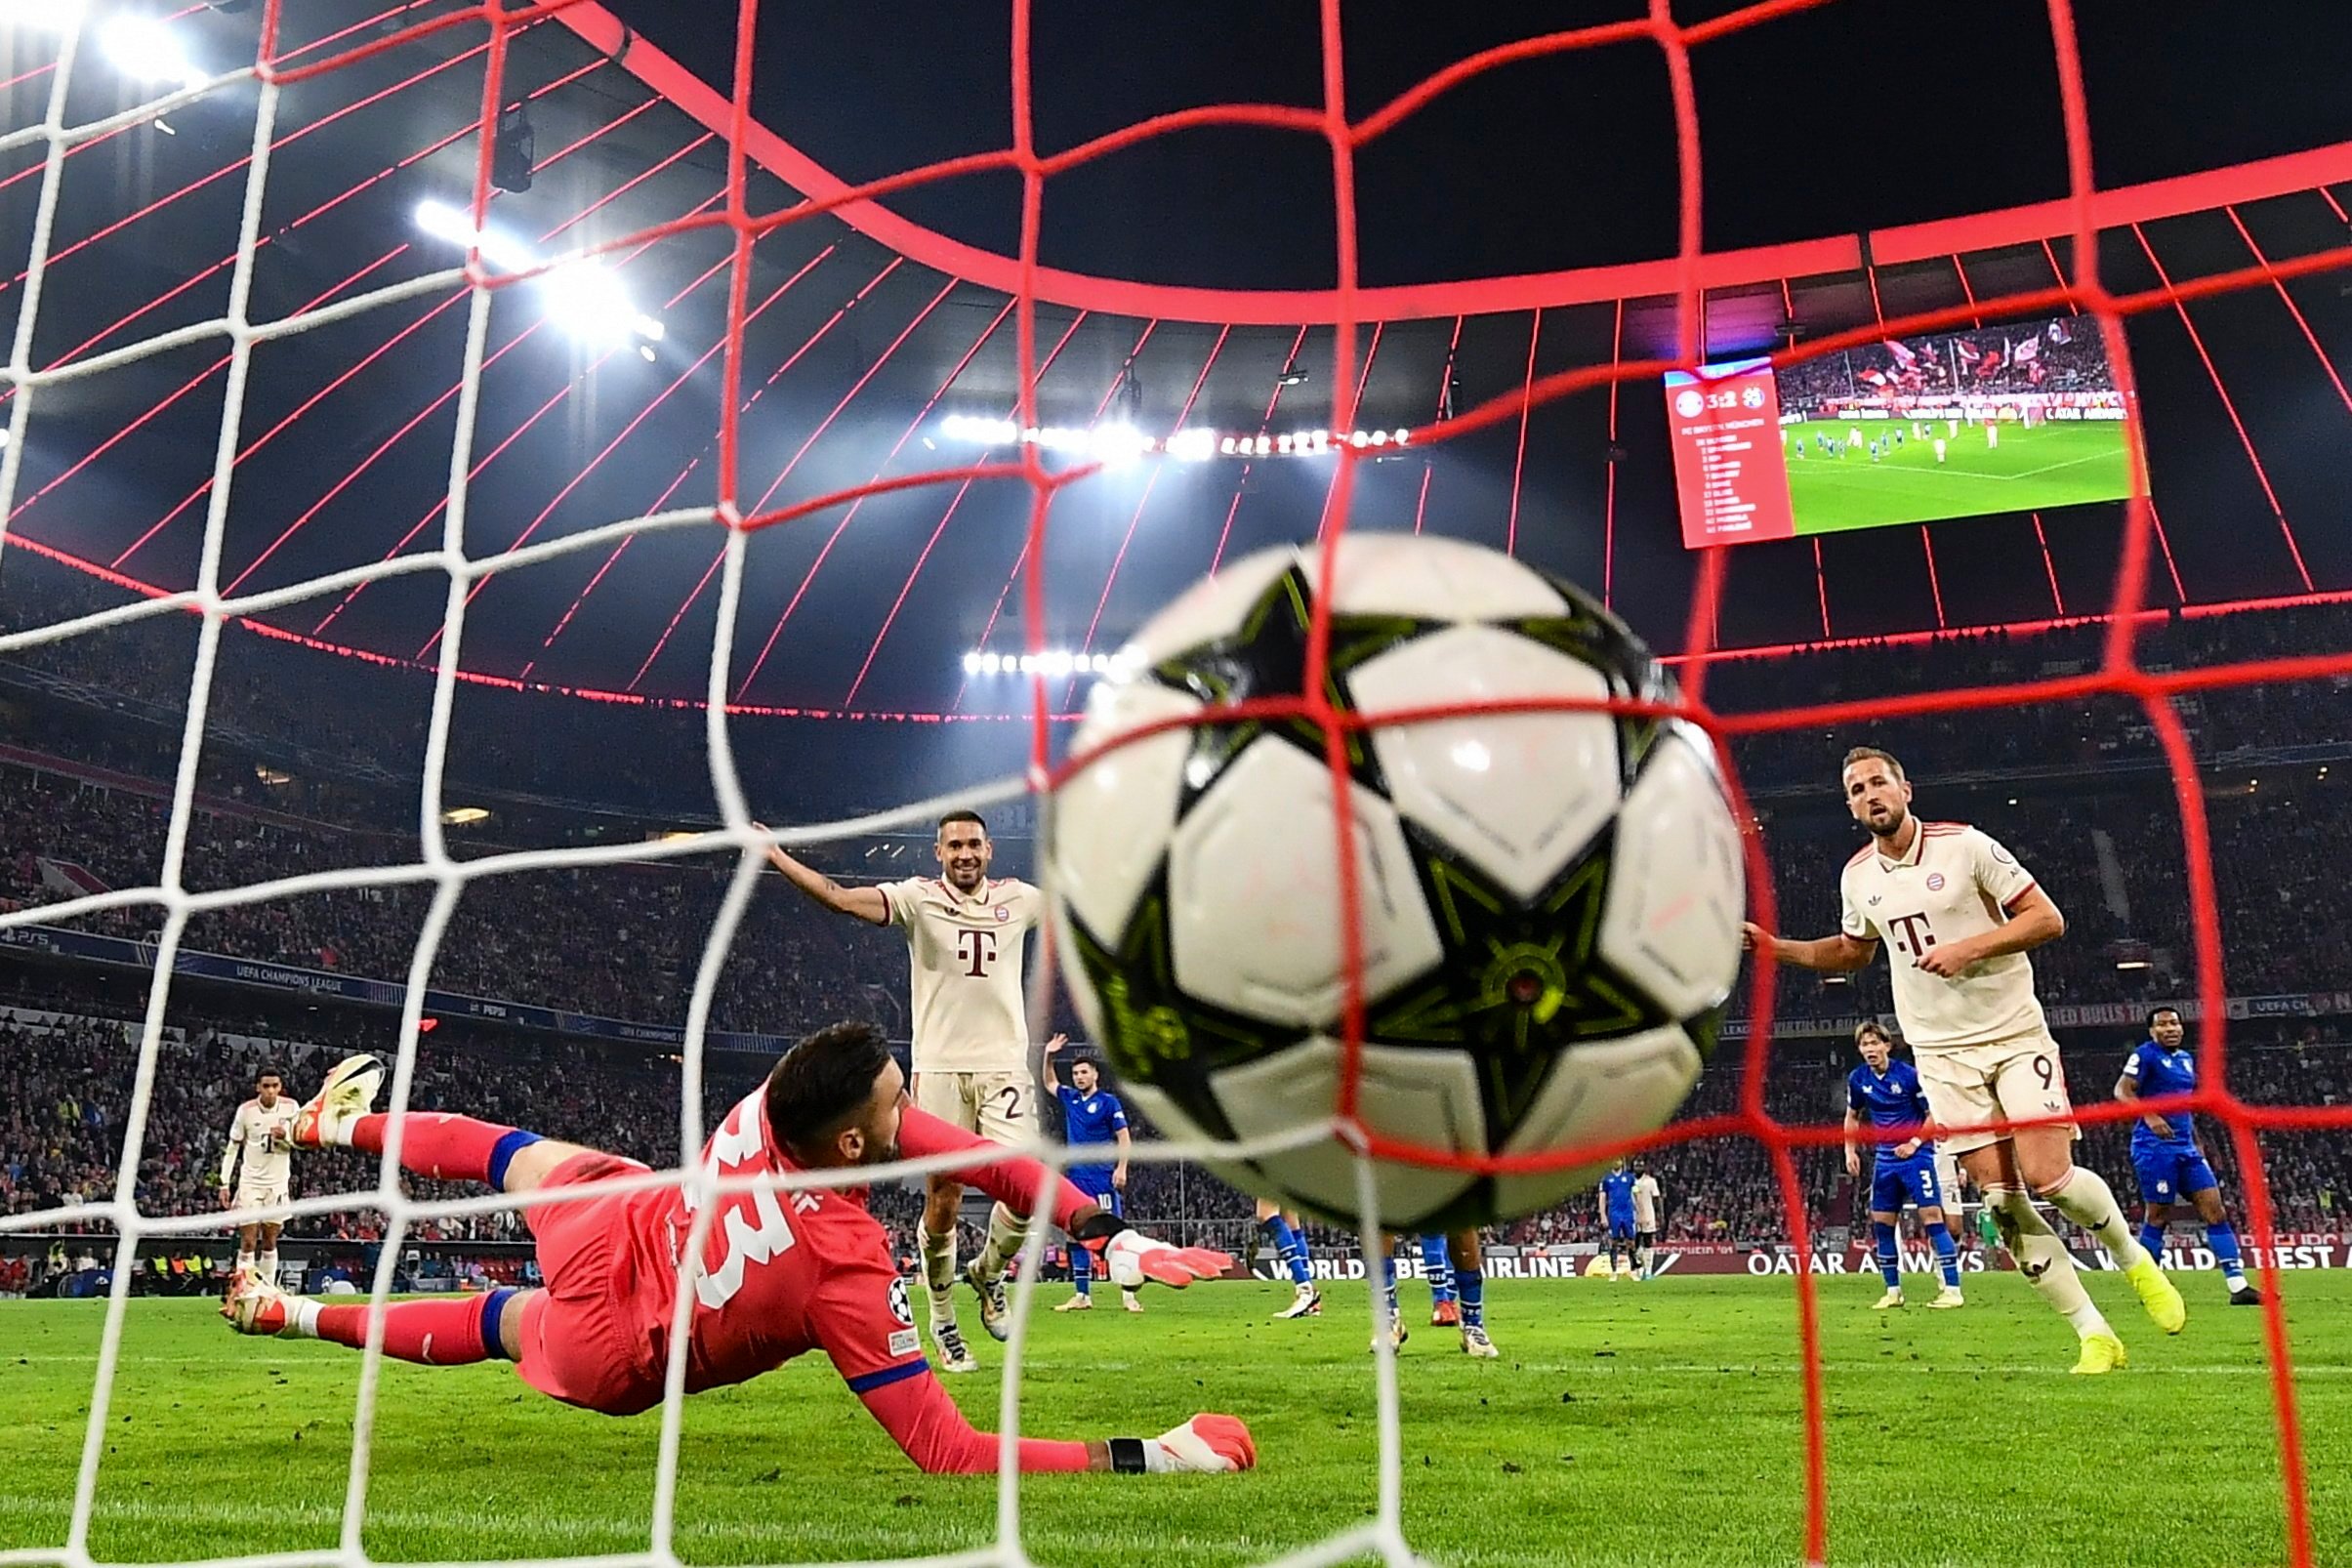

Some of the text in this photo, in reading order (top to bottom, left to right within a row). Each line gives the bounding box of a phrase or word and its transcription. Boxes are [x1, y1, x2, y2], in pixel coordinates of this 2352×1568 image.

[18, 930, 49, 946] PS5
[1887, 912, 1937, 969] T
[958, 929, 997, 978] T
[236, 966, 343, 992] UEFA CHAMPIONS LEAGUE
[2256, 1001, 2290, 1012] UEFA
[2033, 1054, 2052, 1091] 9
[1919, 1170, 1933, 1189] 3
[1097, 1193, 1112, 1210] 10
